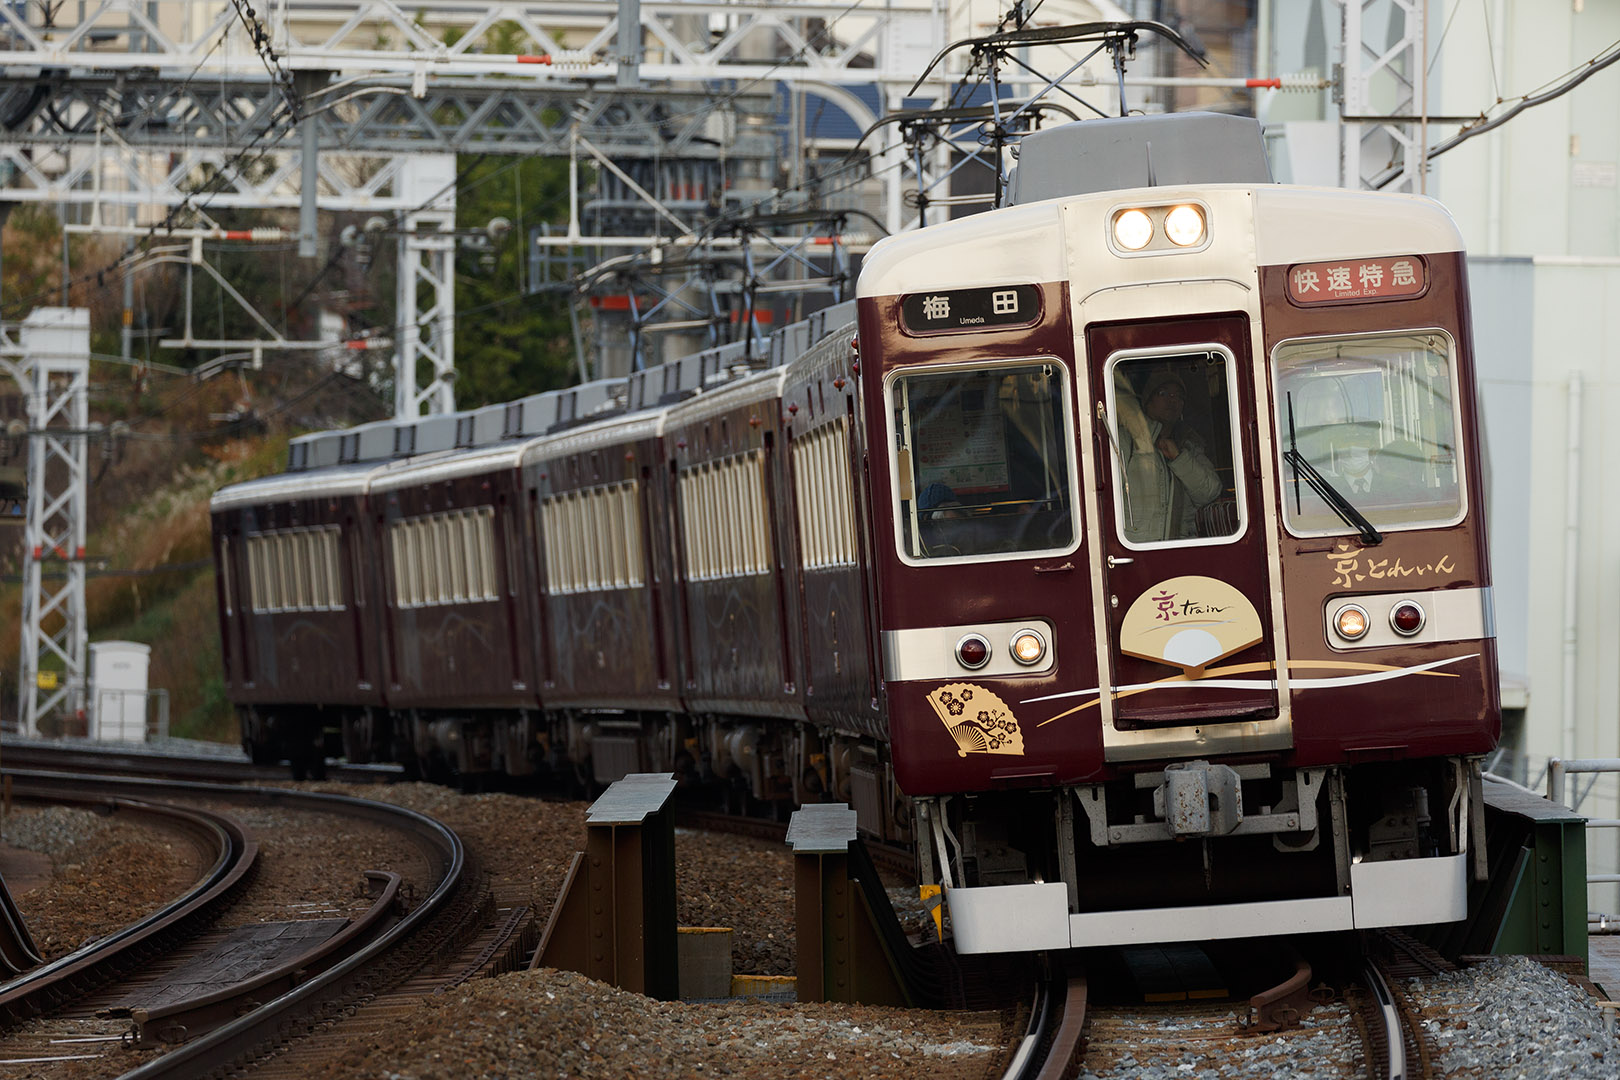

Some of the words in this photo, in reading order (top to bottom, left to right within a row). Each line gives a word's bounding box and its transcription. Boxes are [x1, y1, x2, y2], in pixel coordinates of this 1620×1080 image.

[1294, 261, 1417, 294] 快速特急
[922, 290, 1019, 321] 梅田
[1334, 289, 1361, 298] Limited
[959, 316, 985, 325] Umeda
[1326, 544, 1456, 588] 京とれいん
